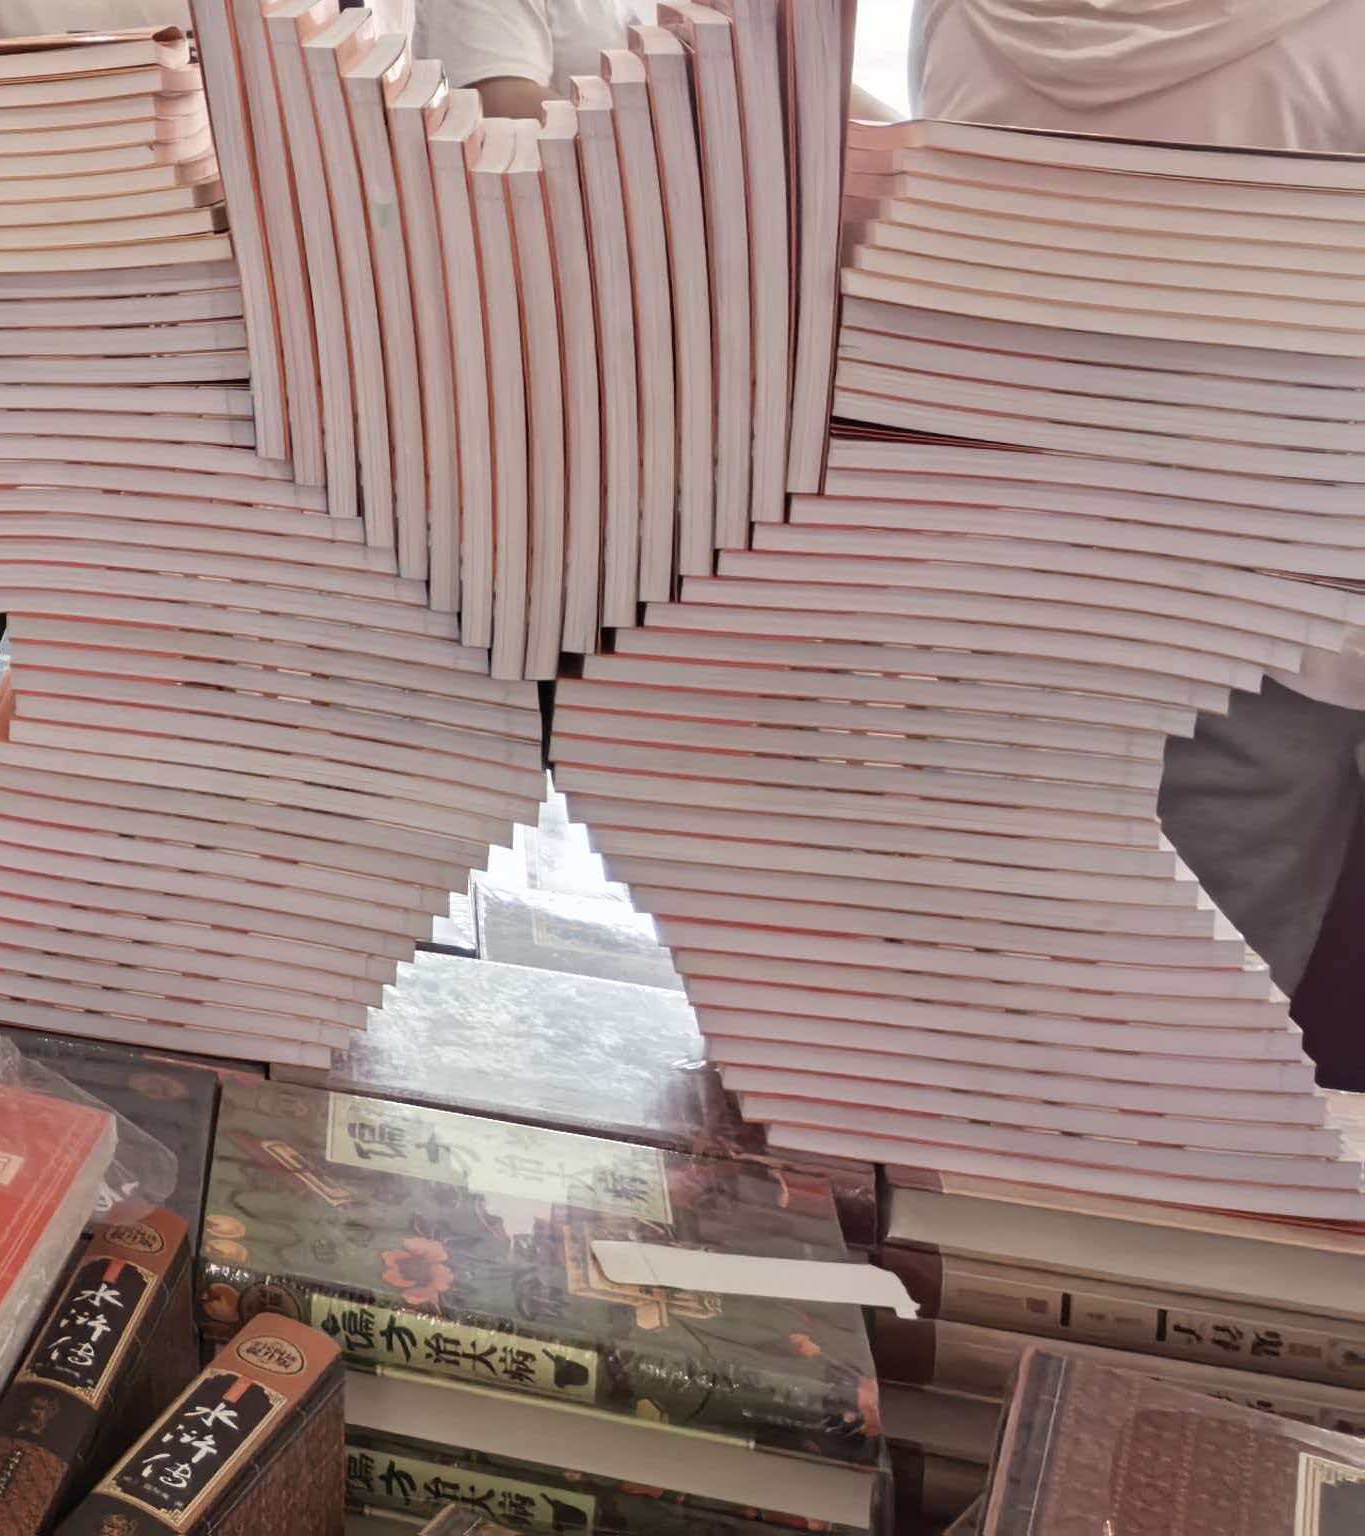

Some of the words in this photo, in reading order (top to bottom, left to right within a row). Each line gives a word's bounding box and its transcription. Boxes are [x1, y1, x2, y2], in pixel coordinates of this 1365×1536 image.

[48, 1282, 126, 1367] 水浒传
[340, 1307, 538, 1385] 偏方治大病
[142, 1401, 241, 1490] 水浒传
